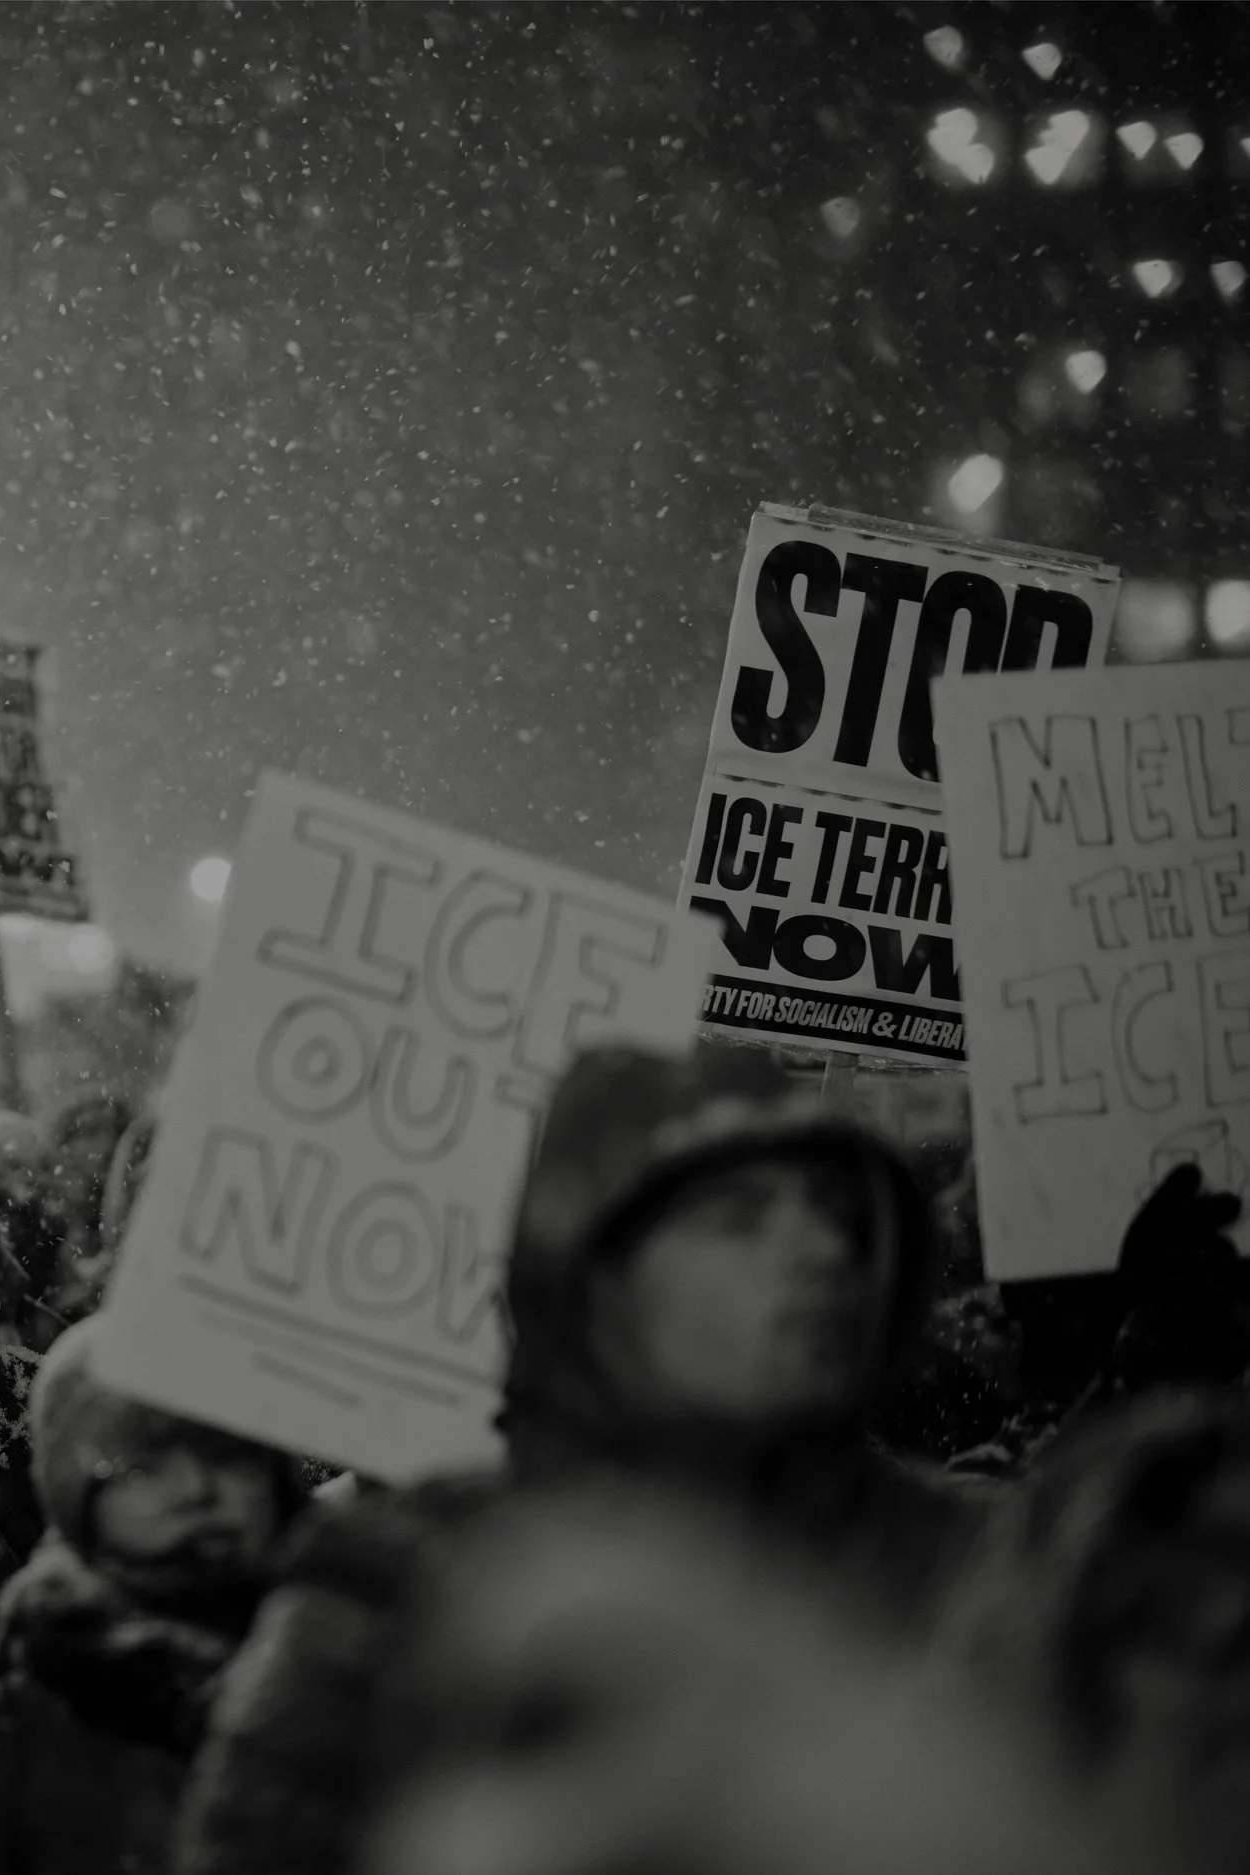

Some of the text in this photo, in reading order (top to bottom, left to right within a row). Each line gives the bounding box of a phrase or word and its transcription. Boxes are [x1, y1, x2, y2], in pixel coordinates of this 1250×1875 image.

[695, 793, 804, 899] ICE
[1070, 850, 1250, 950] THE
[735, 990, 777, 1022] FOR
[774, 995, 874, 1035] SOCIALISM
[871, 1011, 899, 1038] &
[1003, 952, 1250, 1125] ICE
[255, 994, 547, 1164] OU
